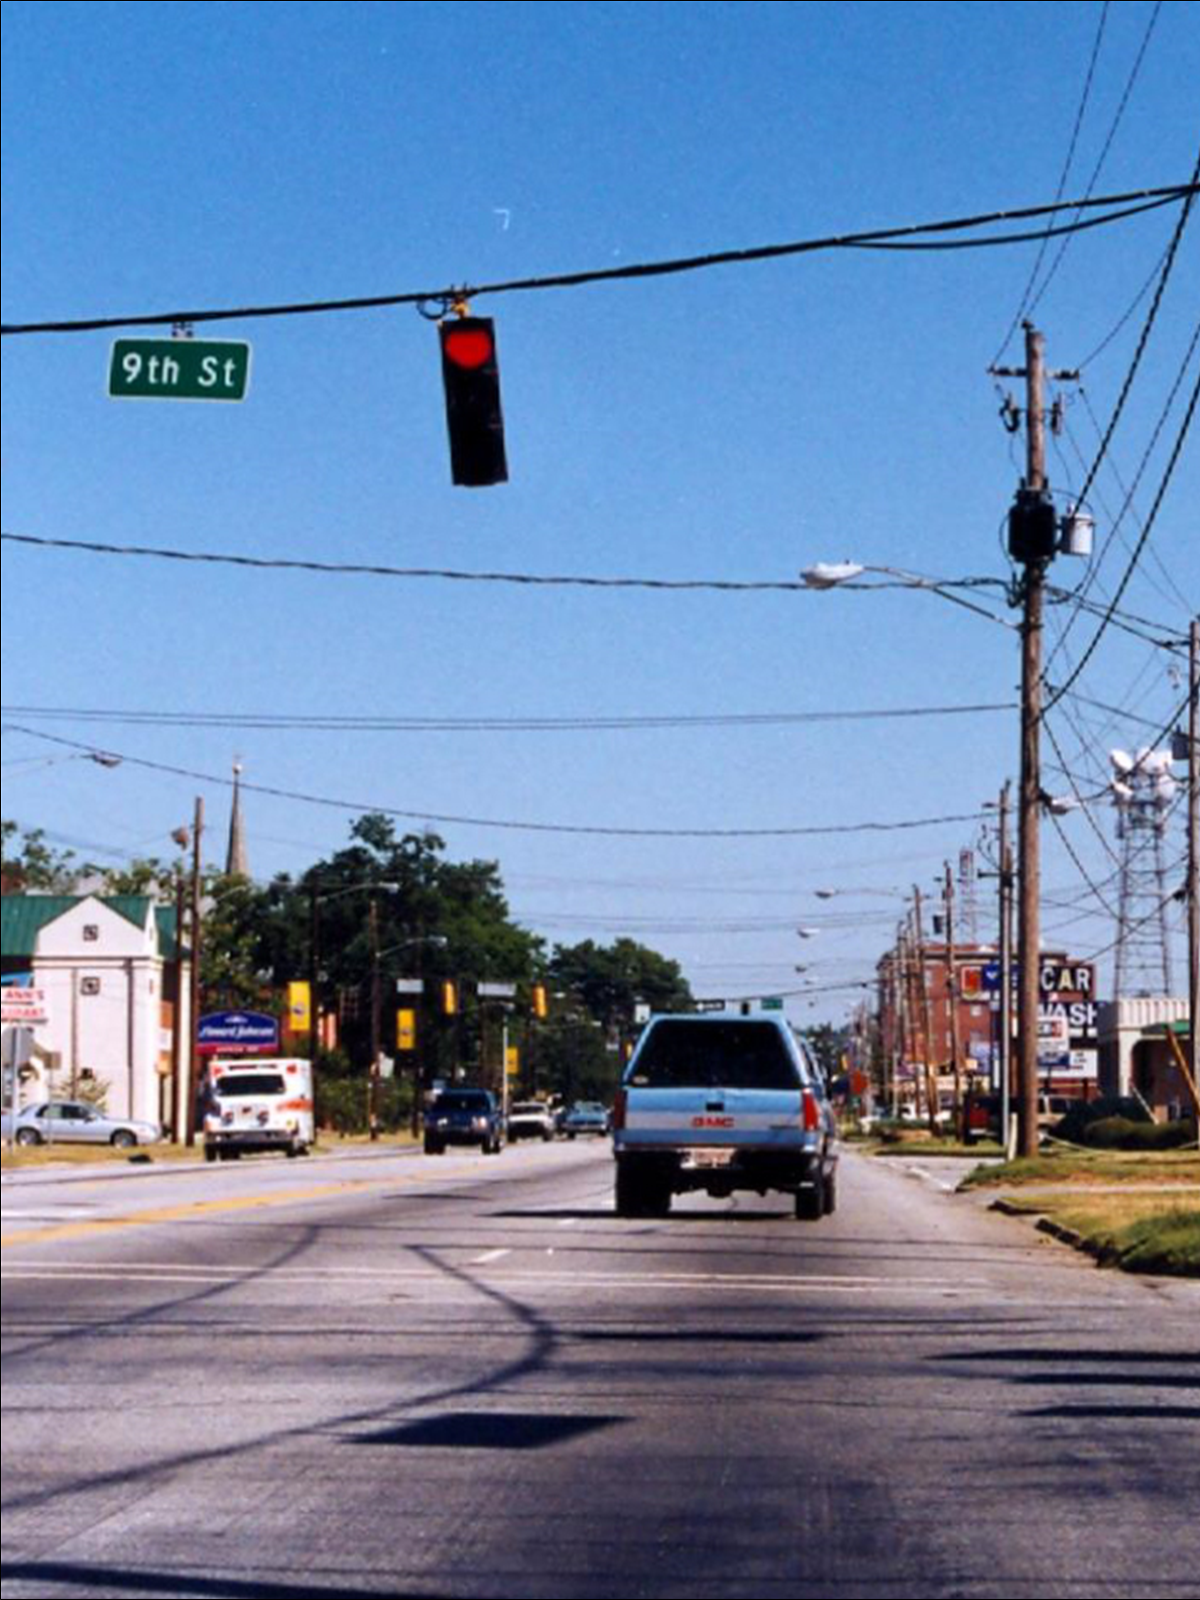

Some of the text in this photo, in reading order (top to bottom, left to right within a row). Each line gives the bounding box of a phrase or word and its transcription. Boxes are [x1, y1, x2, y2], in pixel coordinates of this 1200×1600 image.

[123, 352, 236, 387] 9th St
[1040, 966, 1092, 991] CAR
[692, 1116, 735, 1128] GMC
